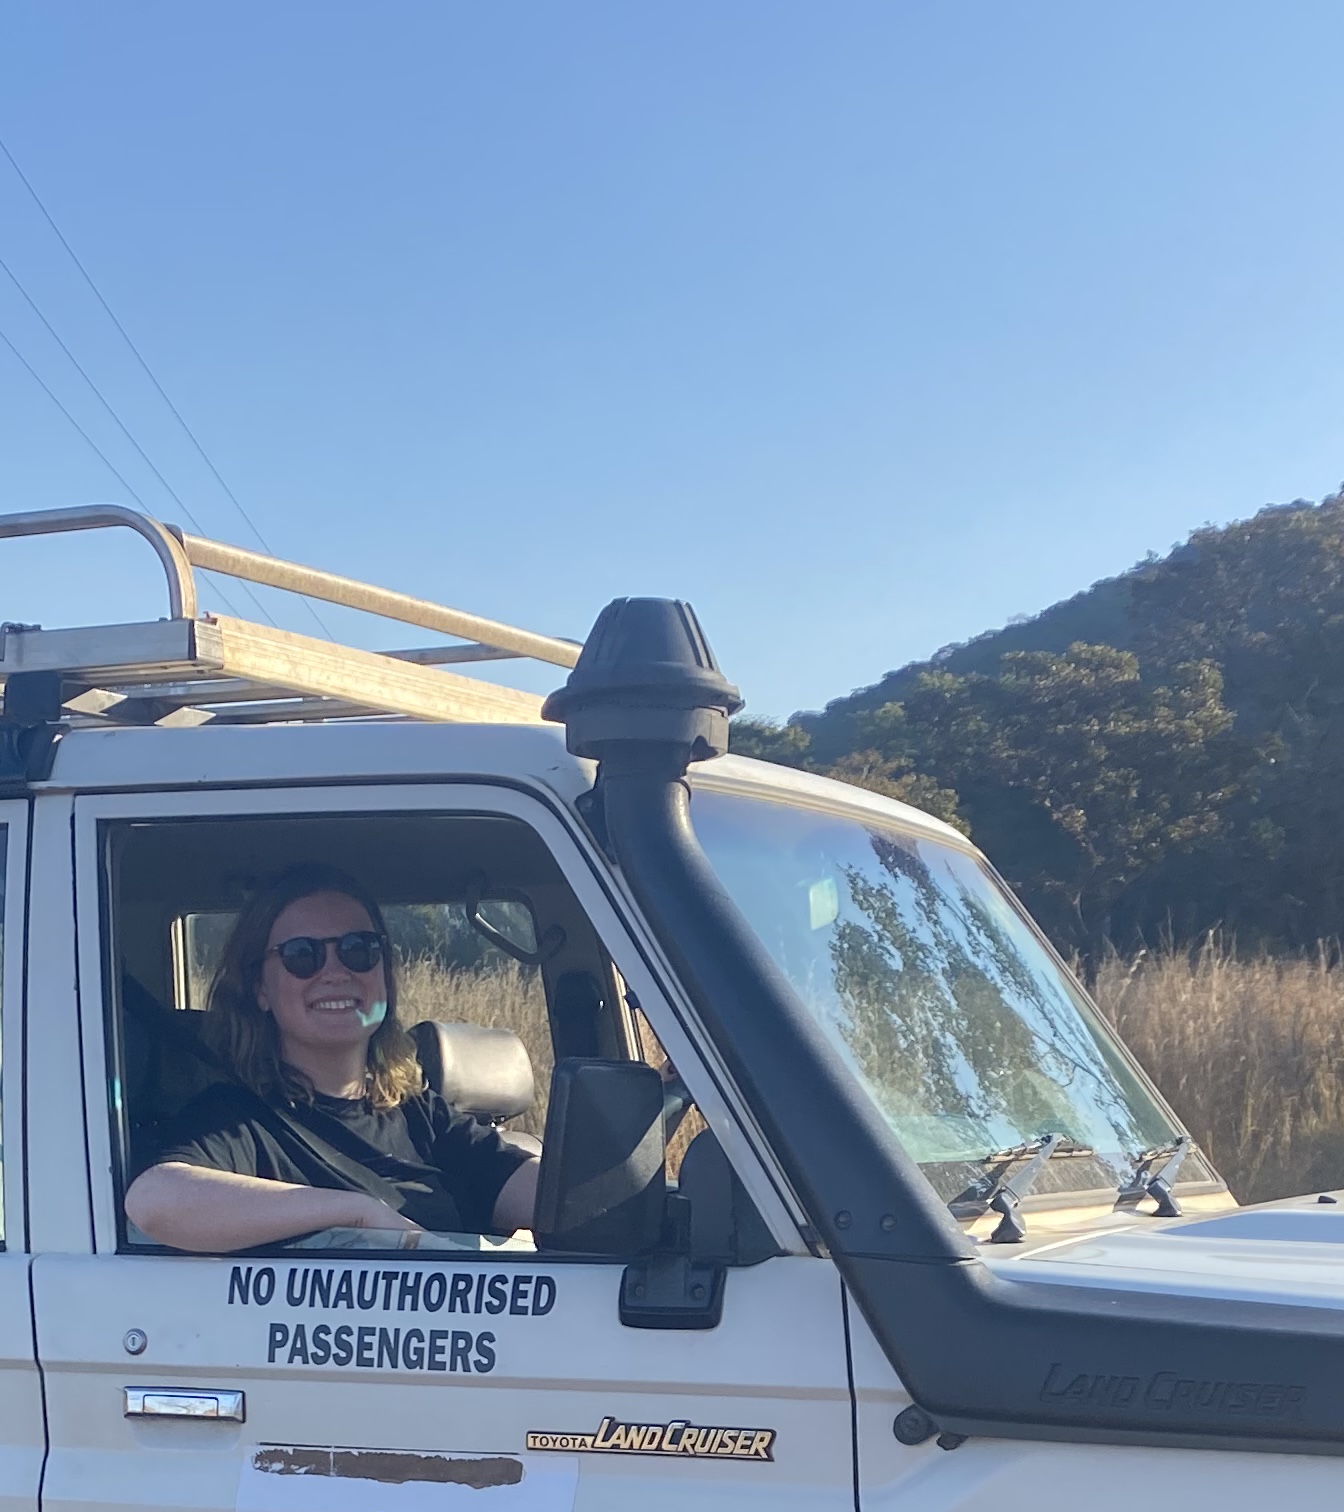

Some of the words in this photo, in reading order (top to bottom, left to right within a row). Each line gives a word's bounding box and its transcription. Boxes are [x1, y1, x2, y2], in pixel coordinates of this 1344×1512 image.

[228, 1265, 276, 1306] NO
[286, 1267, 557, 1316] UNAUTHORISED
[267, 1322, 497, 1373] PASSENGERS
[529, 1434, 588, 1449] TOYOTA
